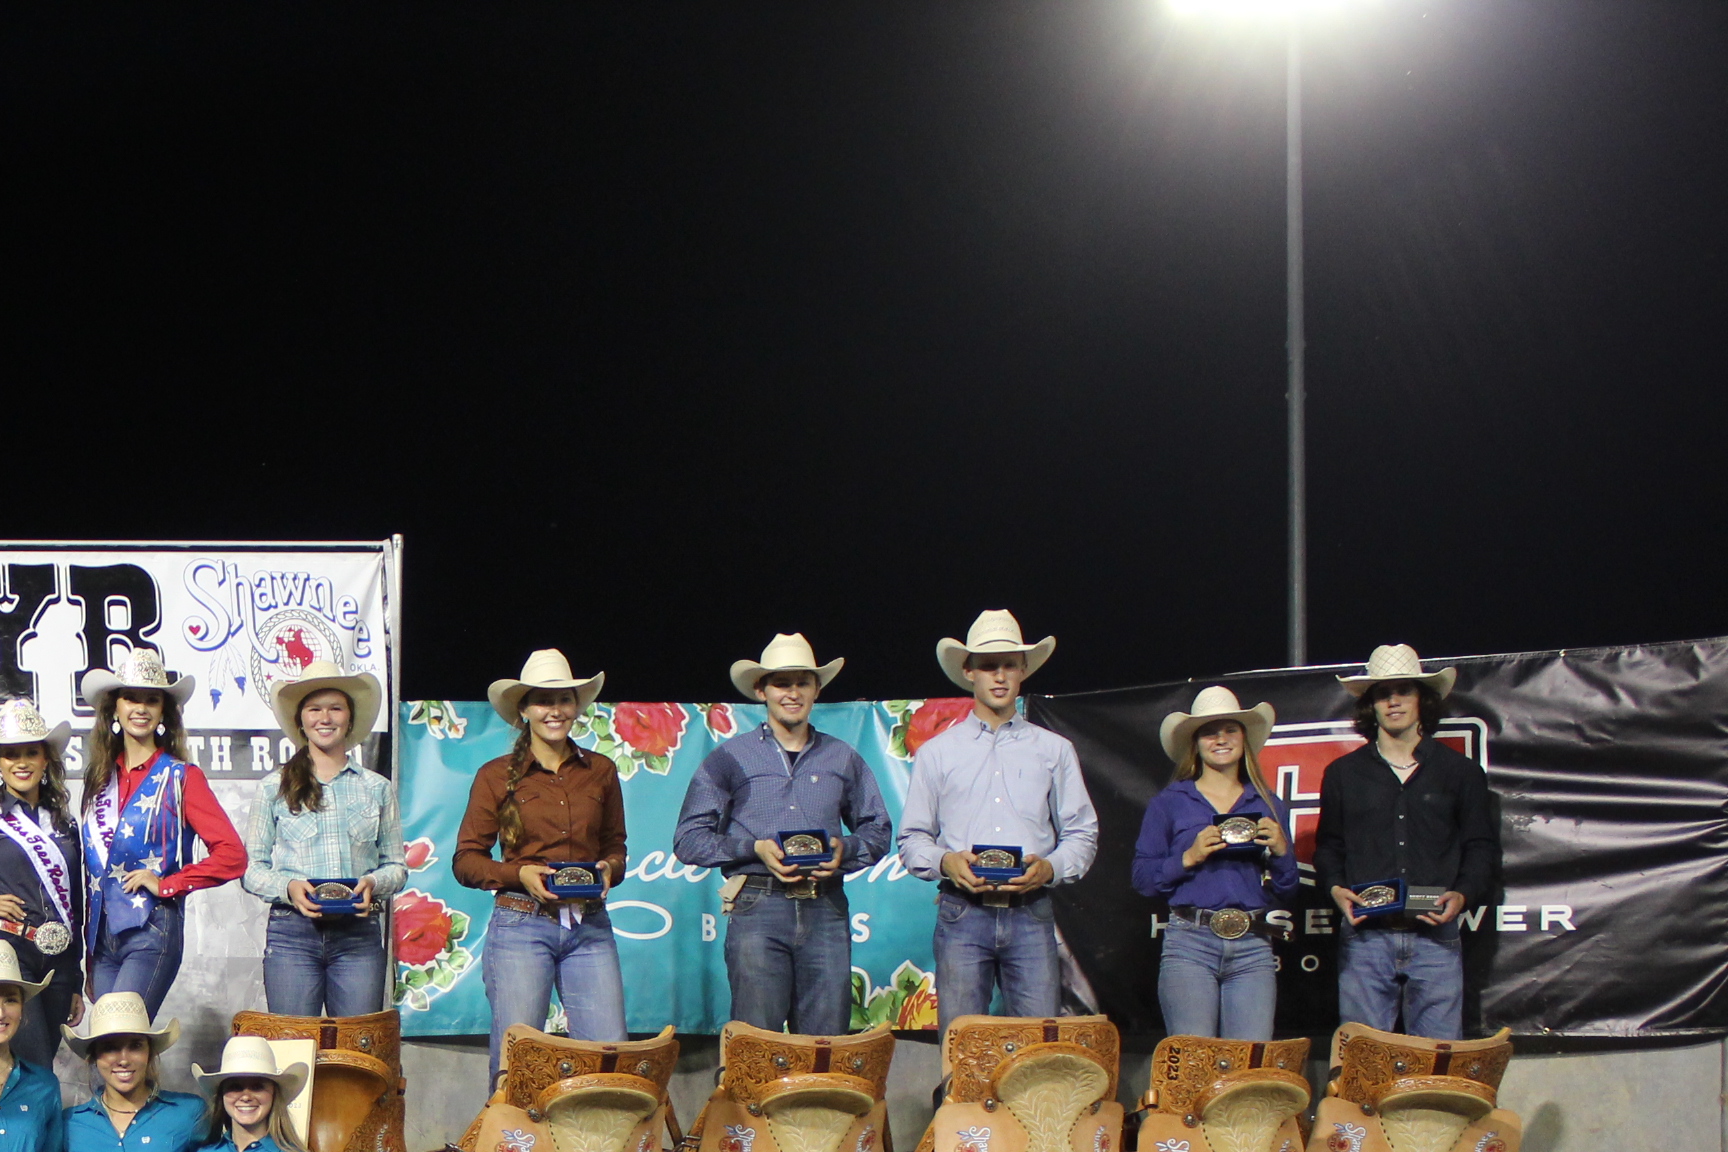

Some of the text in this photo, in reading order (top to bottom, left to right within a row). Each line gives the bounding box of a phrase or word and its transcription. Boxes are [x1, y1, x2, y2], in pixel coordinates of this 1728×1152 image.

[182, 558, 372, 663] Shawnee
[27, 834, 52, 867] Teen
[1166, 1046, 1182, 1081] 2023
